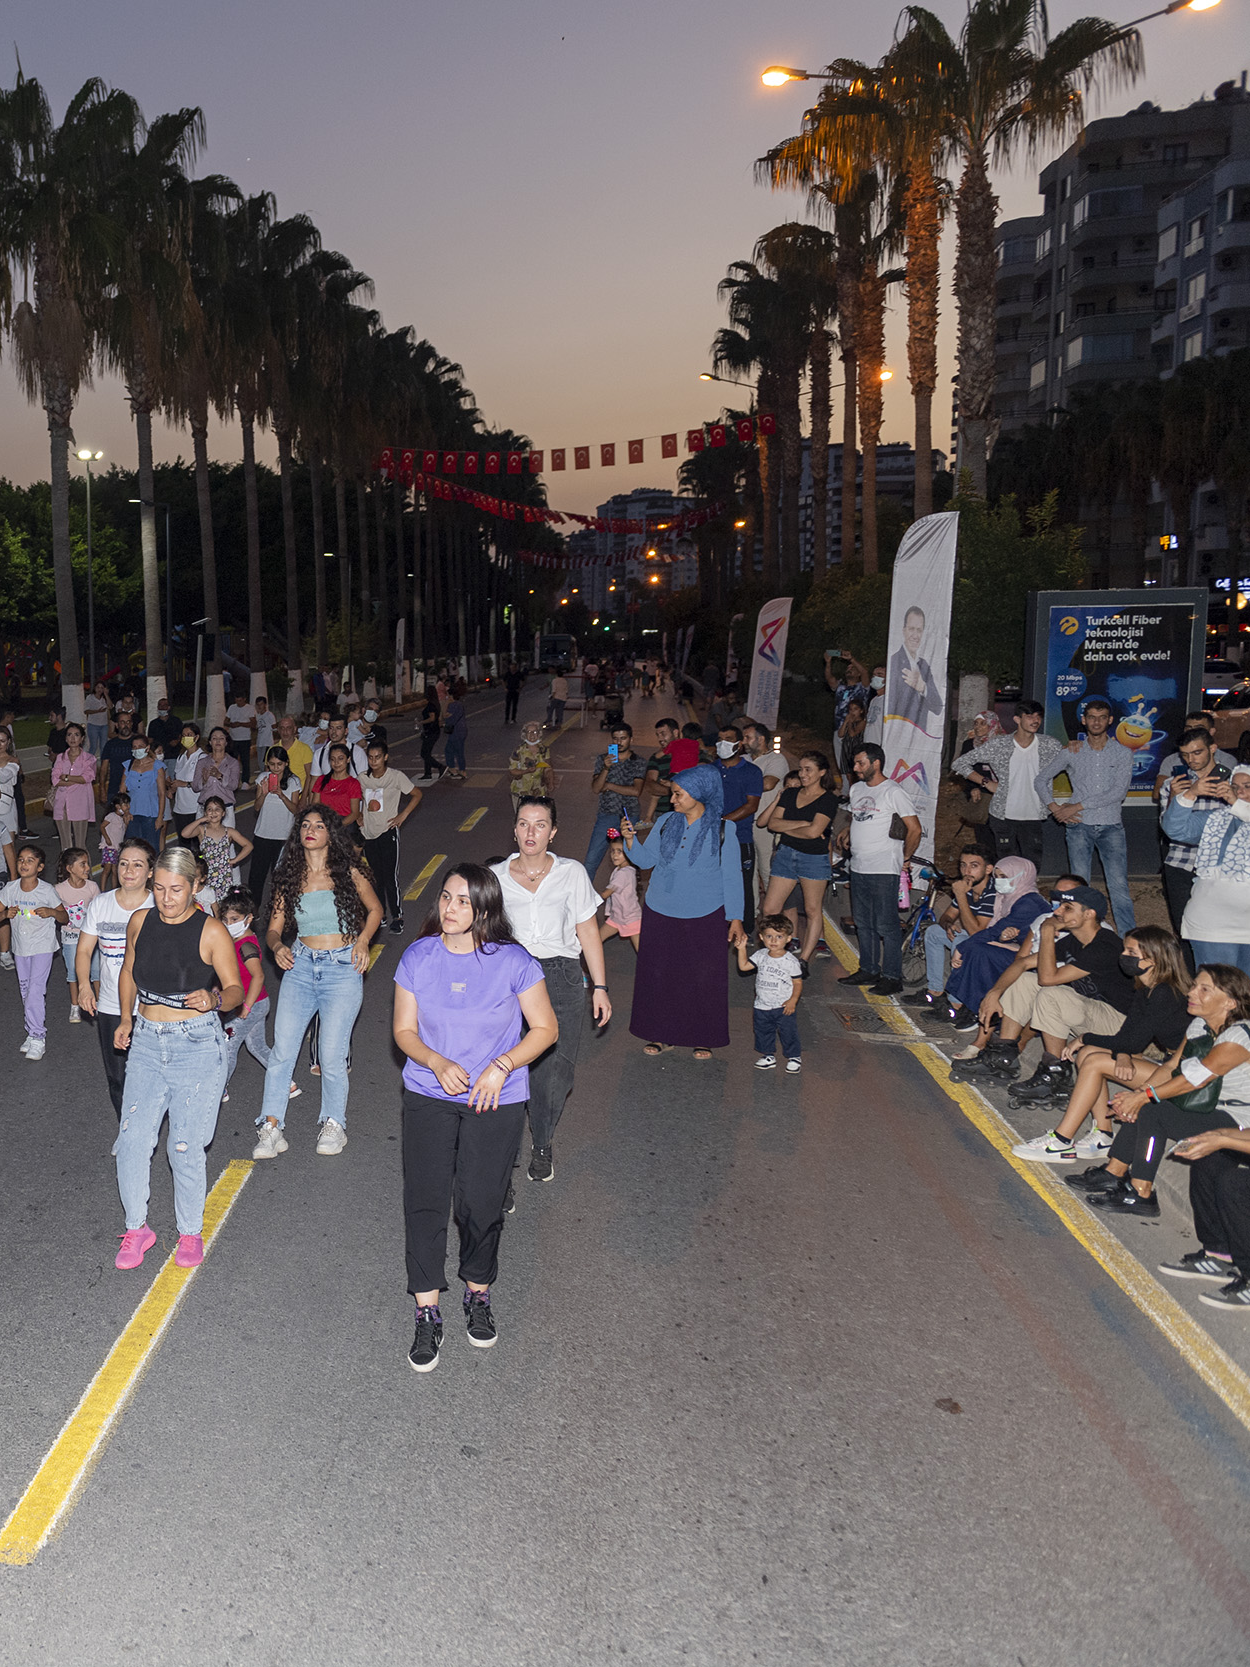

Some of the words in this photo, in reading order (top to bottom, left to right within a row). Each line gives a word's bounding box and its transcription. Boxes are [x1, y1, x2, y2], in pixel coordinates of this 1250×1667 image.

[1086, 615, 1129, 625] Turkcell
[1132, 615, 1162, 625] Fiber
[1085, 627, 1144, 639] teknolojisi
[1083, 652, 1113, 661] daha
[1116, 651, 1137, 662] çok
[1140, 650, 1171, 661] evde!
[102, 922, 125, 932] Calvin
